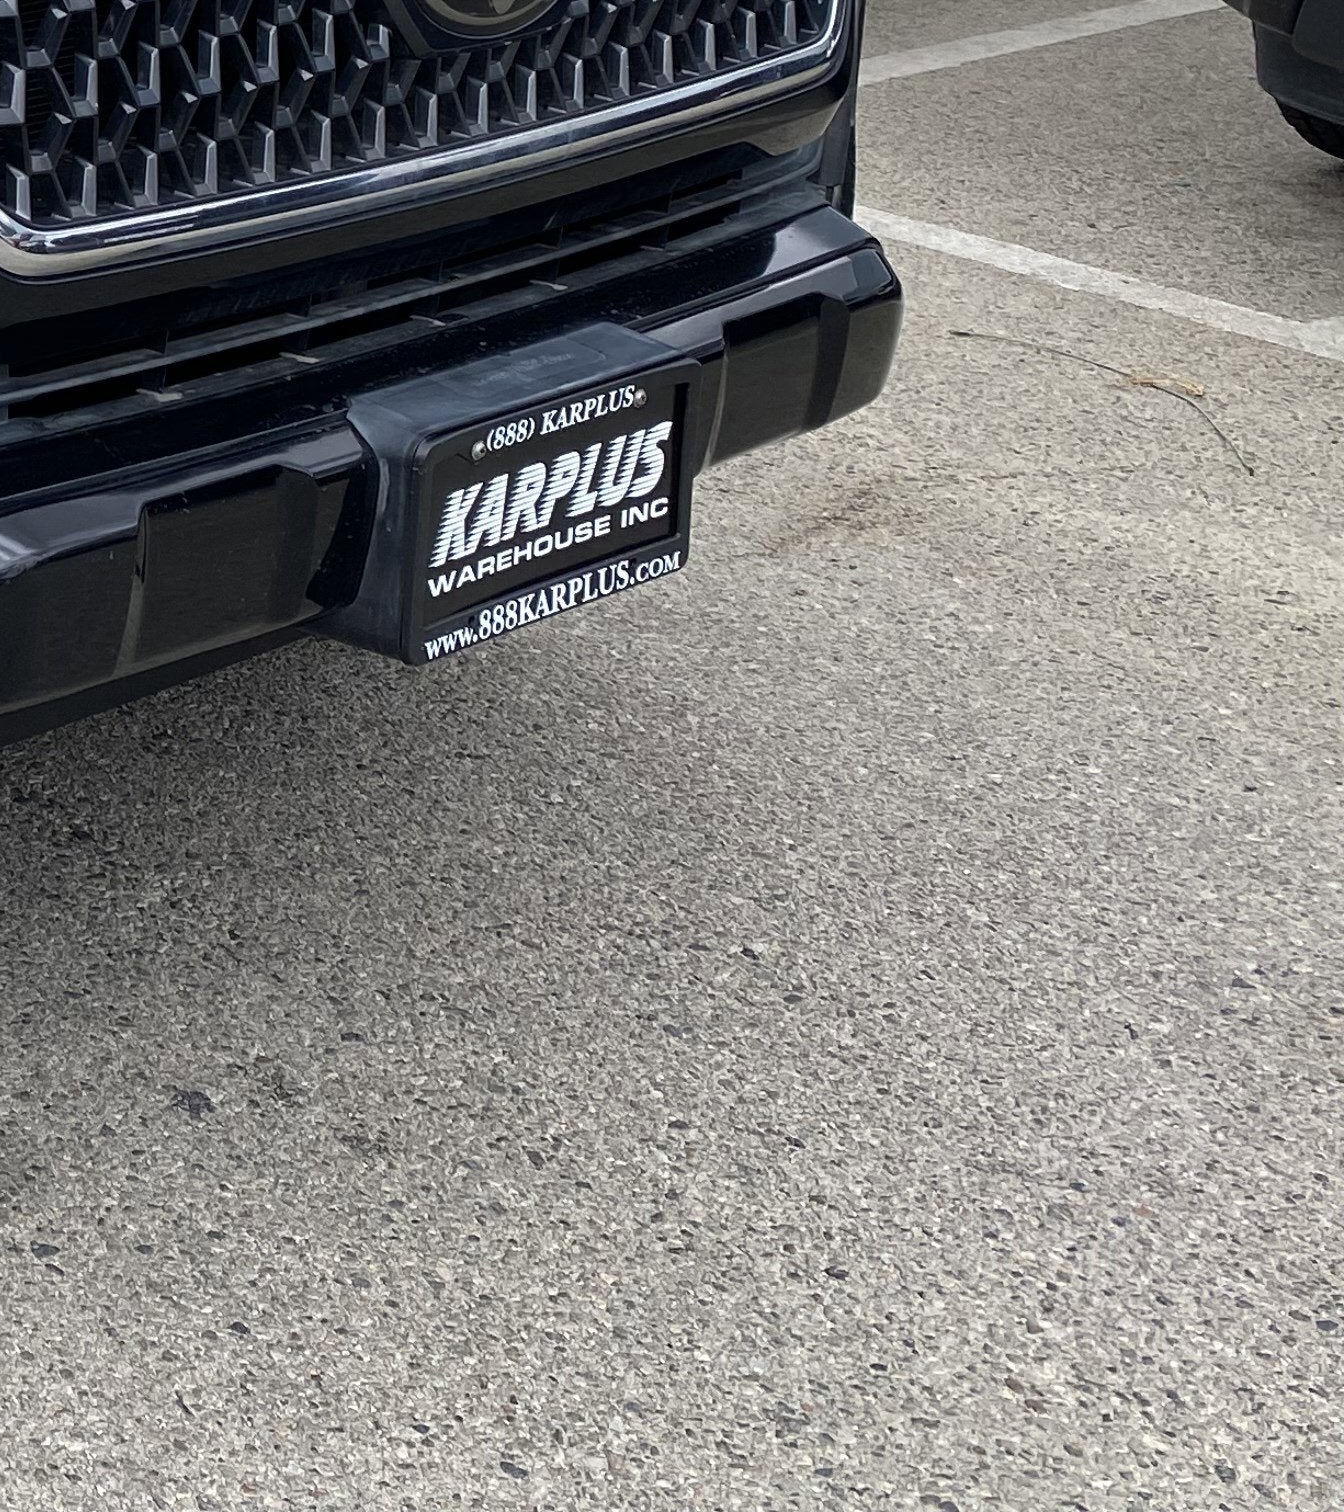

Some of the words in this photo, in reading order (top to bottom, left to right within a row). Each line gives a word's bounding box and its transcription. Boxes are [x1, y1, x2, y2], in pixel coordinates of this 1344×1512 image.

[486, 417, 536, 453] (888)
[540, 385, 636, 437] KARPLUS
[428, 420, 673, 569] KARPLUS
[427, 514, 611, 598] WAREHOUSE
[620, 497, 669, 529] INC
